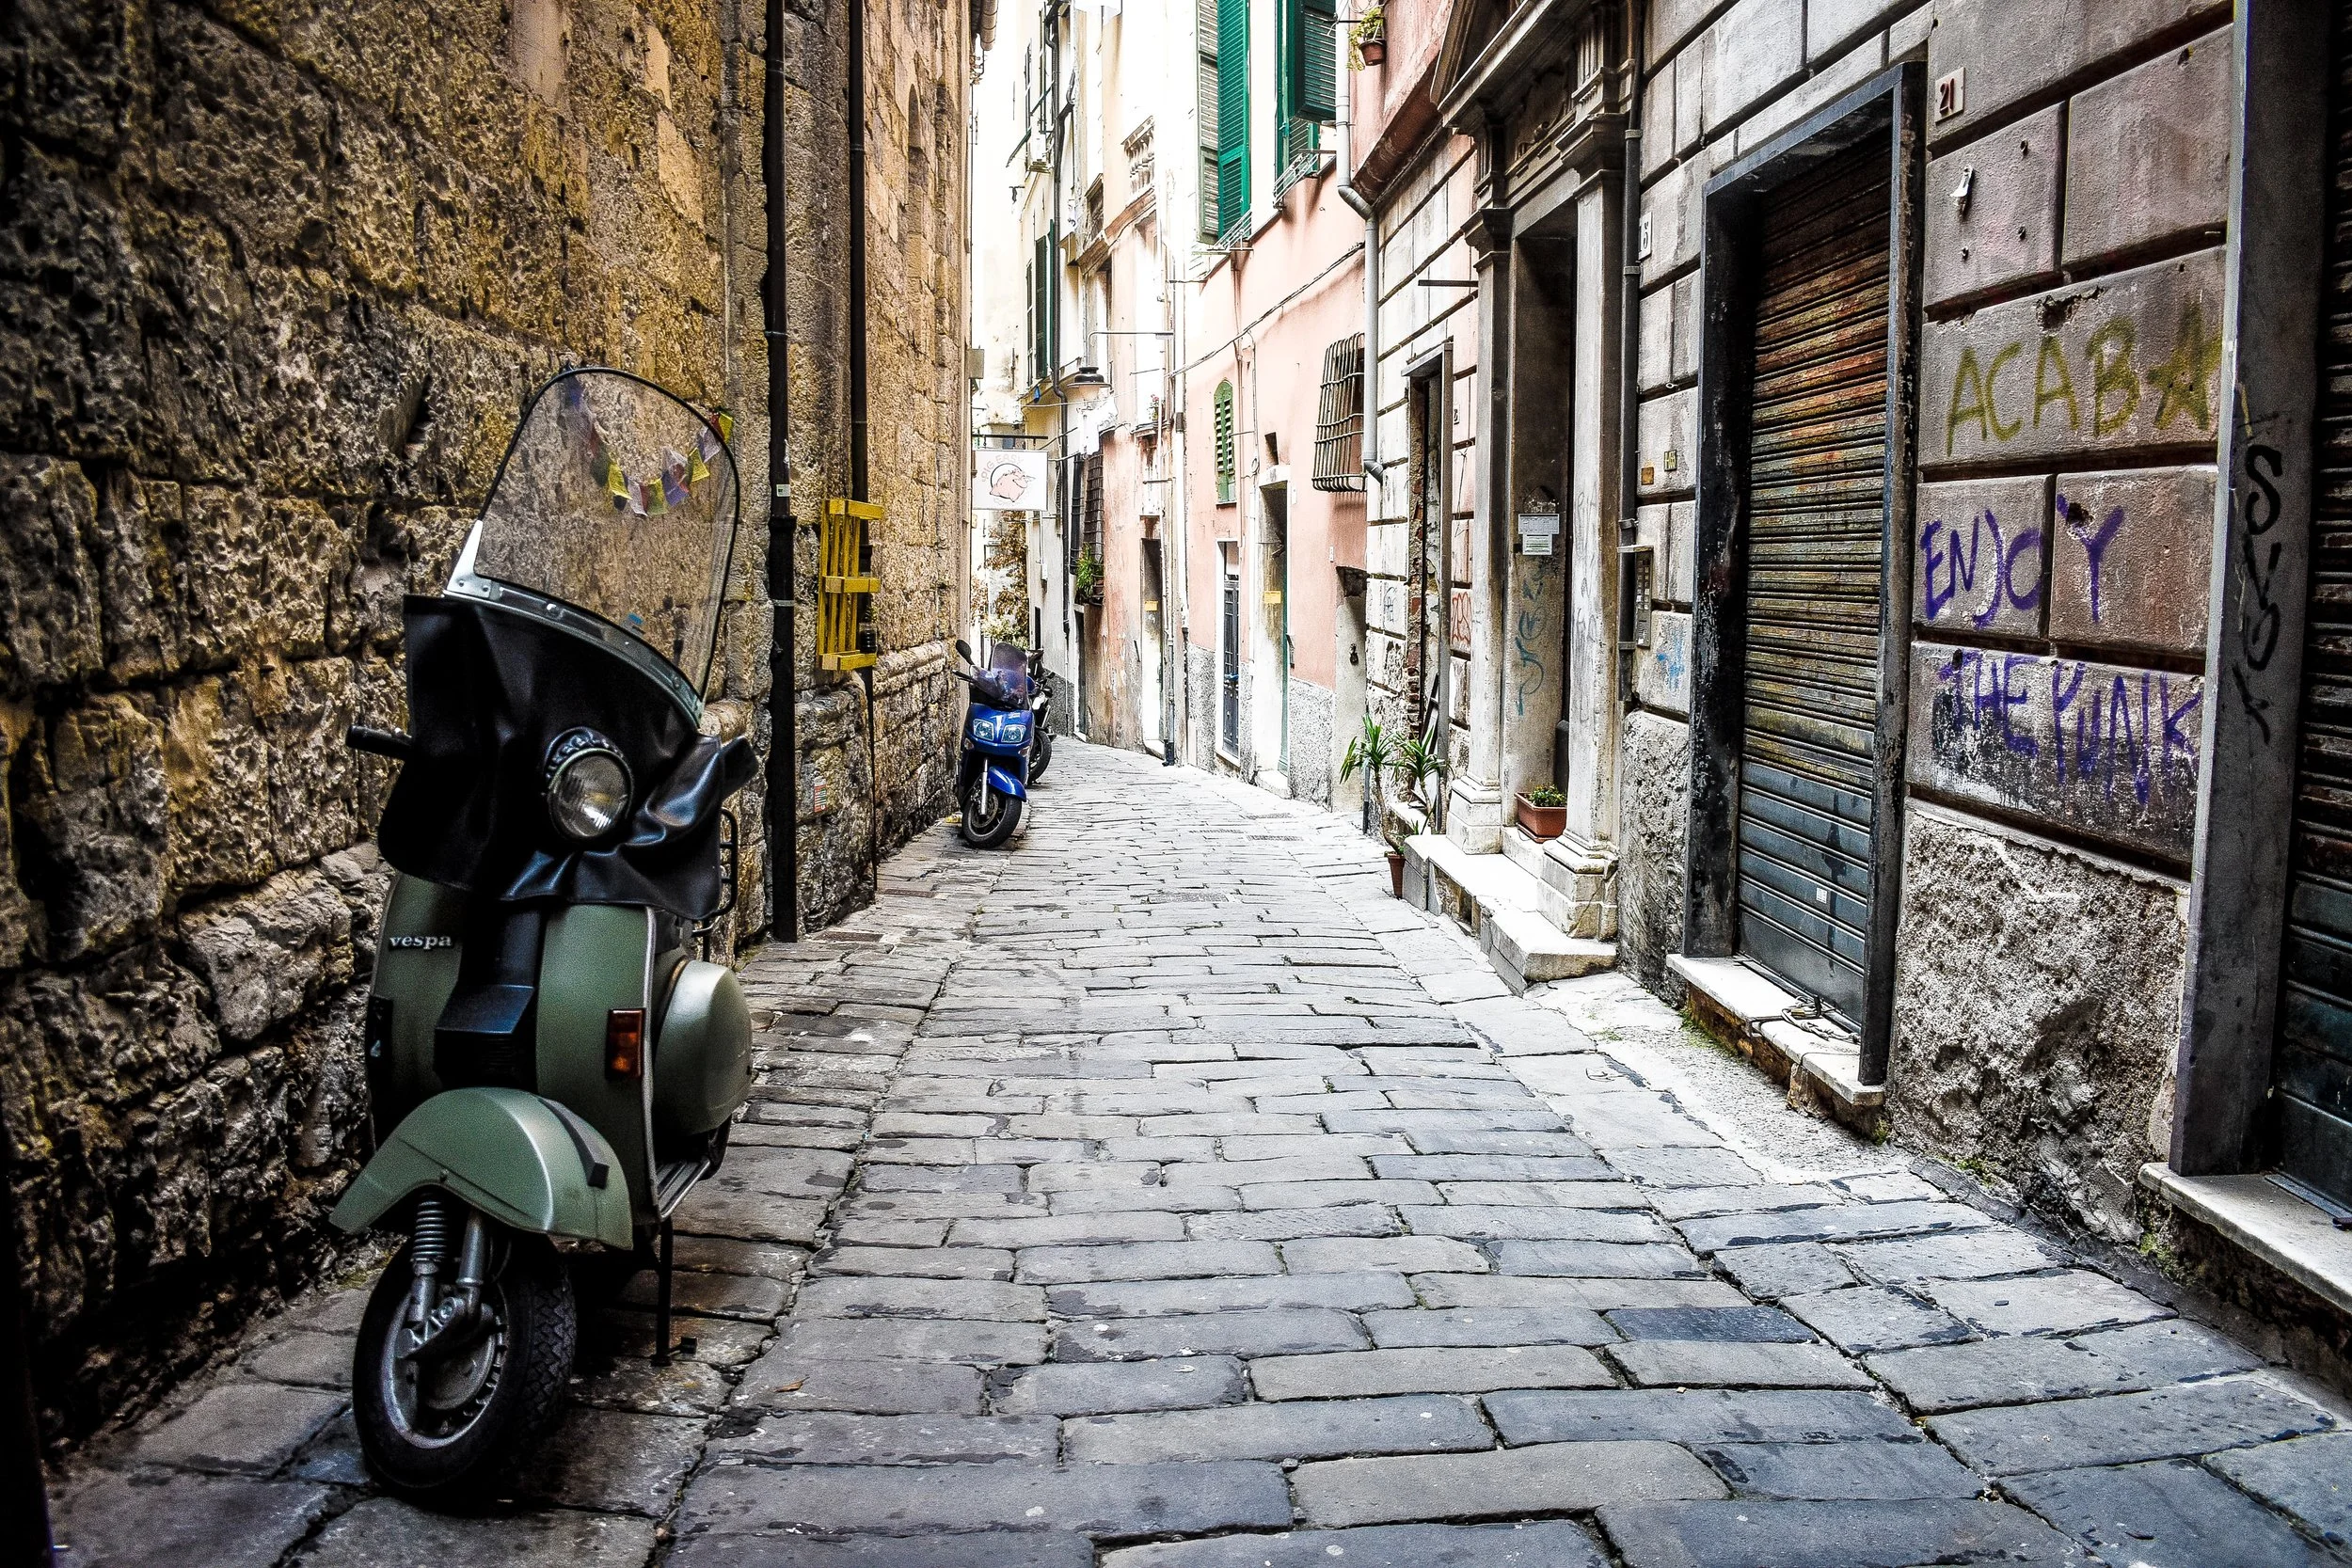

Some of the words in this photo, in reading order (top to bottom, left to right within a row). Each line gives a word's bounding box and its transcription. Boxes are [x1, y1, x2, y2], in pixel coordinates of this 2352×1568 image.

[1939, 78, 1955, 118] 21
[1945, 315, 2142, 458] ACAB
[1920, 494, 2125, 629] ENJOY
[389, 936, 452, 950] vespa
